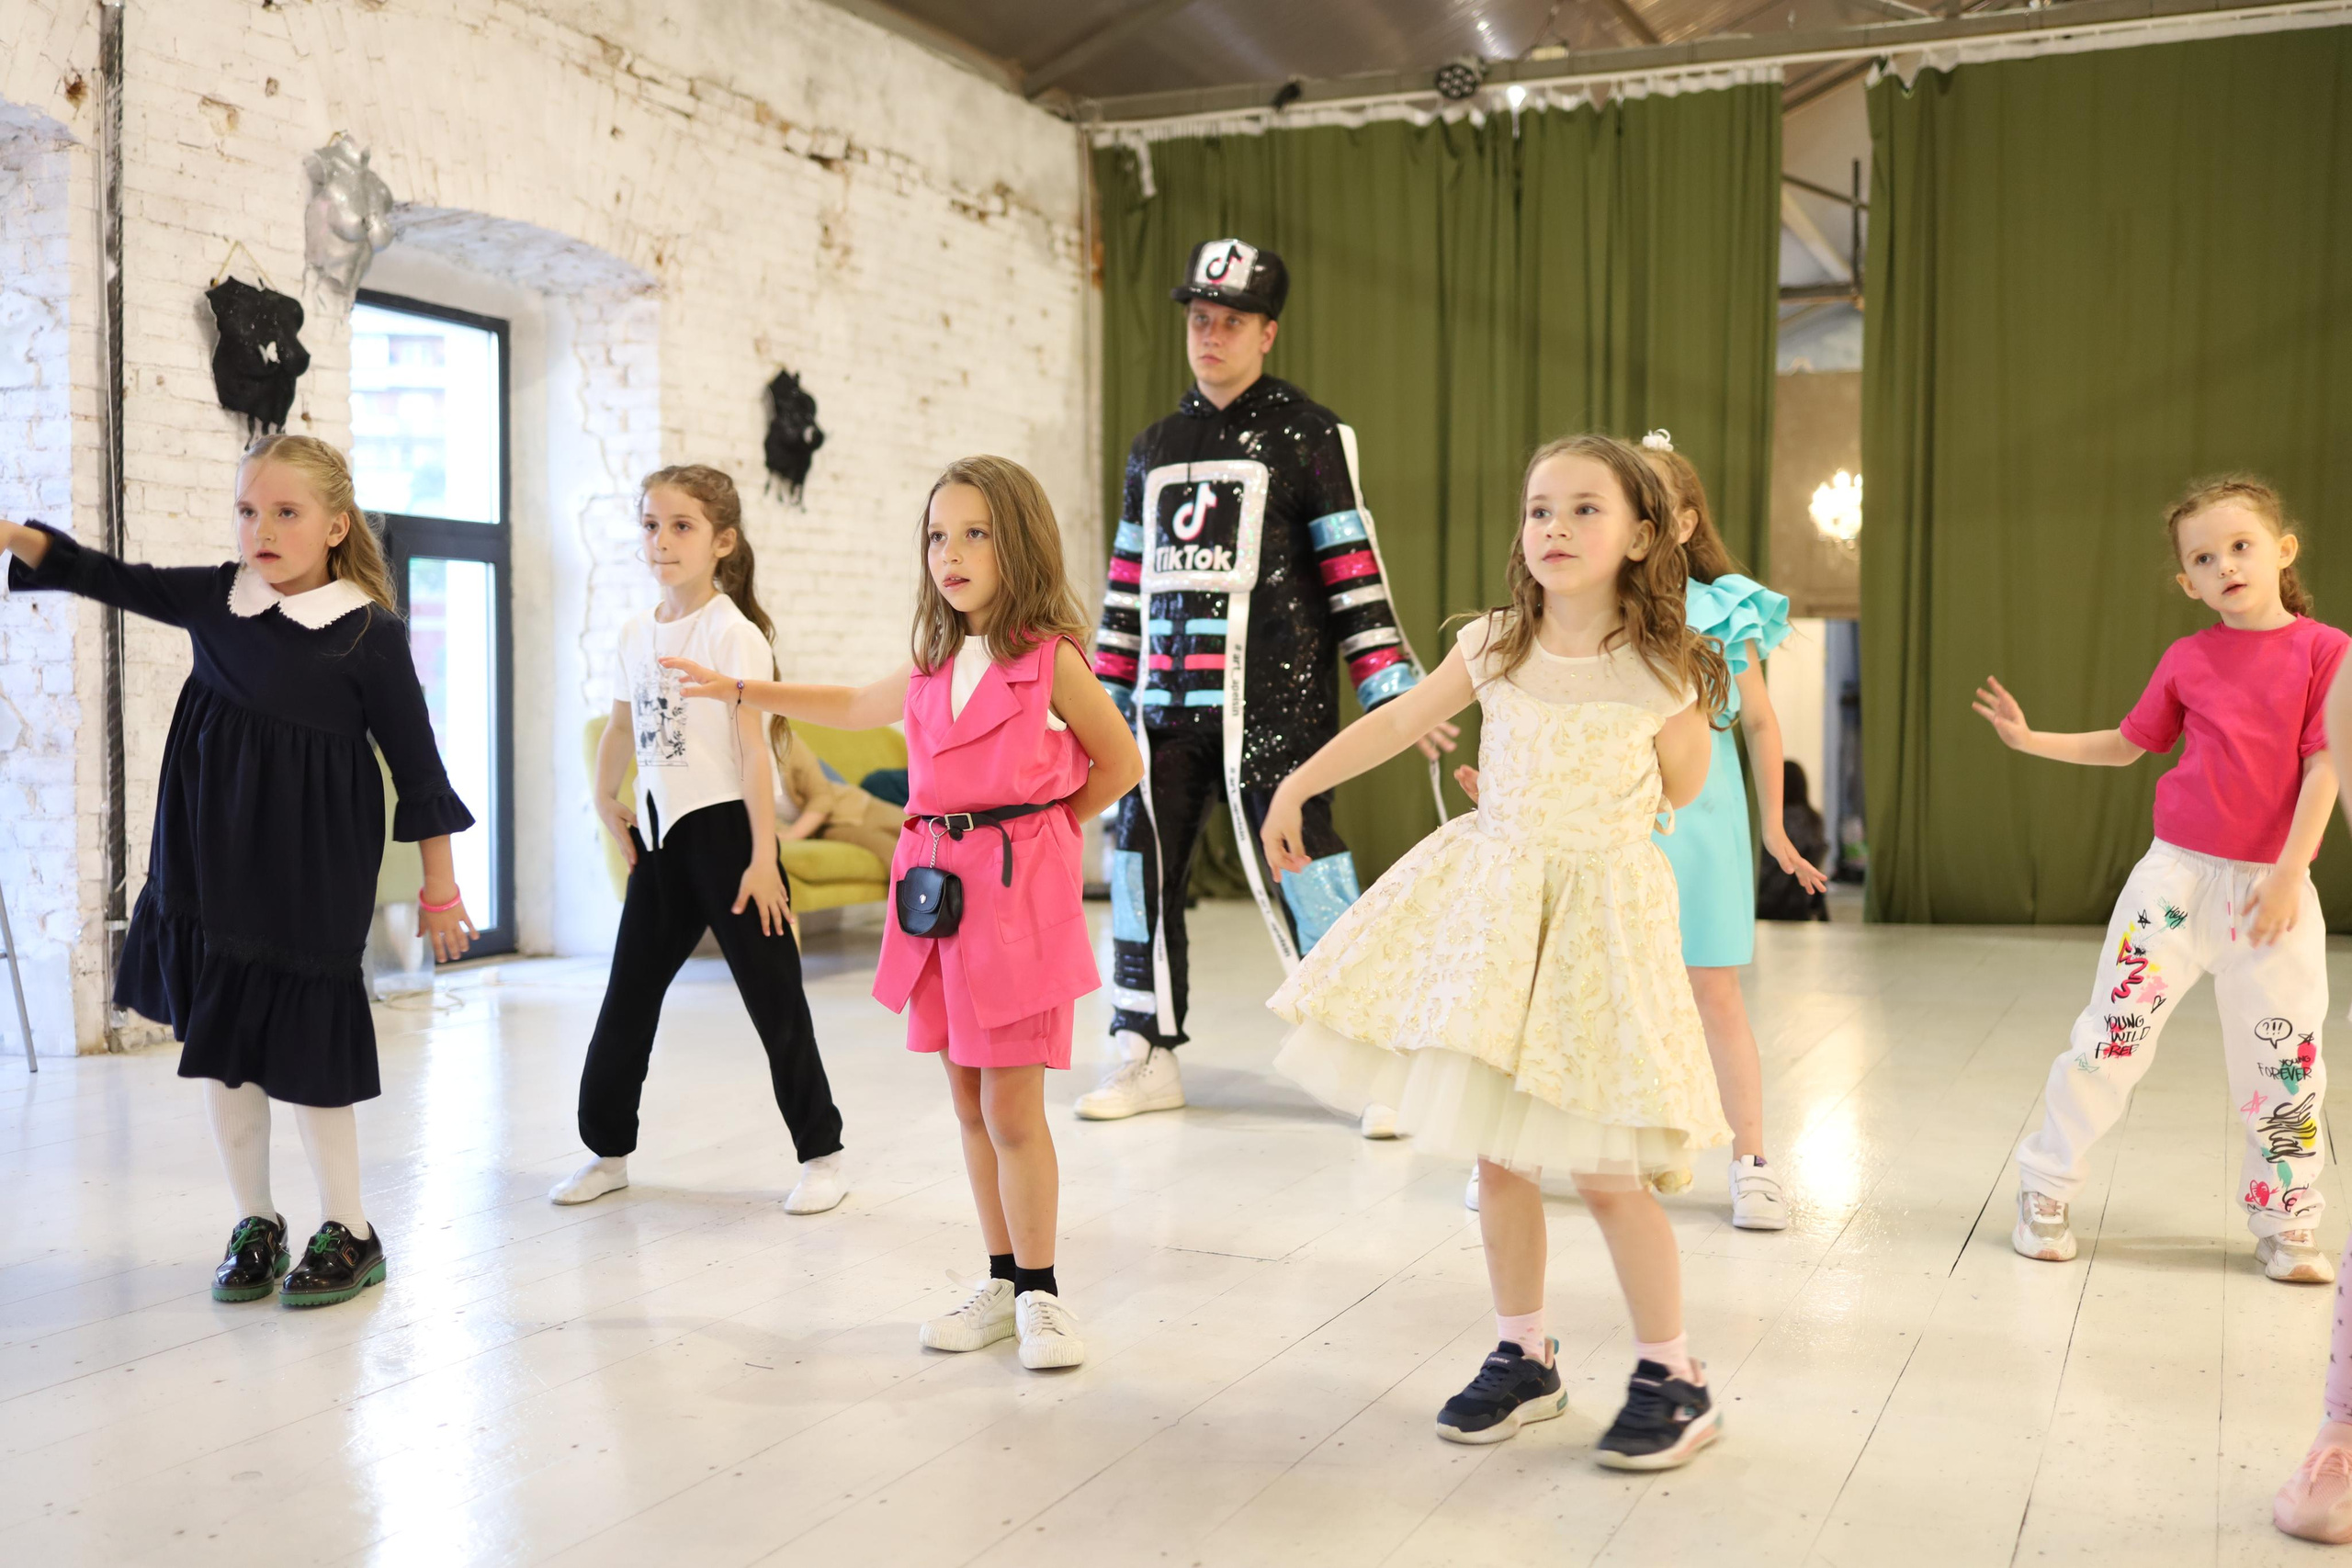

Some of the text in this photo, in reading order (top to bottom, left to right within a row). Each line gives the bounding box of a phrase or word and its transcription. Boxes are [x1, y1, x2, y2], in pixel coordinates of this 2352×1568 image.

[1156, 544, 1233, 572] TikTok
[2164, 905, 2188, 930] Hey
[2104, 1013, 2144, 1032] YOUNG
[2110, 1026, 2151, 1043] WILD
[2095, 1042, 2140, 1059] FREE
[2279, 1055, 2312, 1066] YOUNG
[2256, 1062, 2312, 1081] FOREVER
